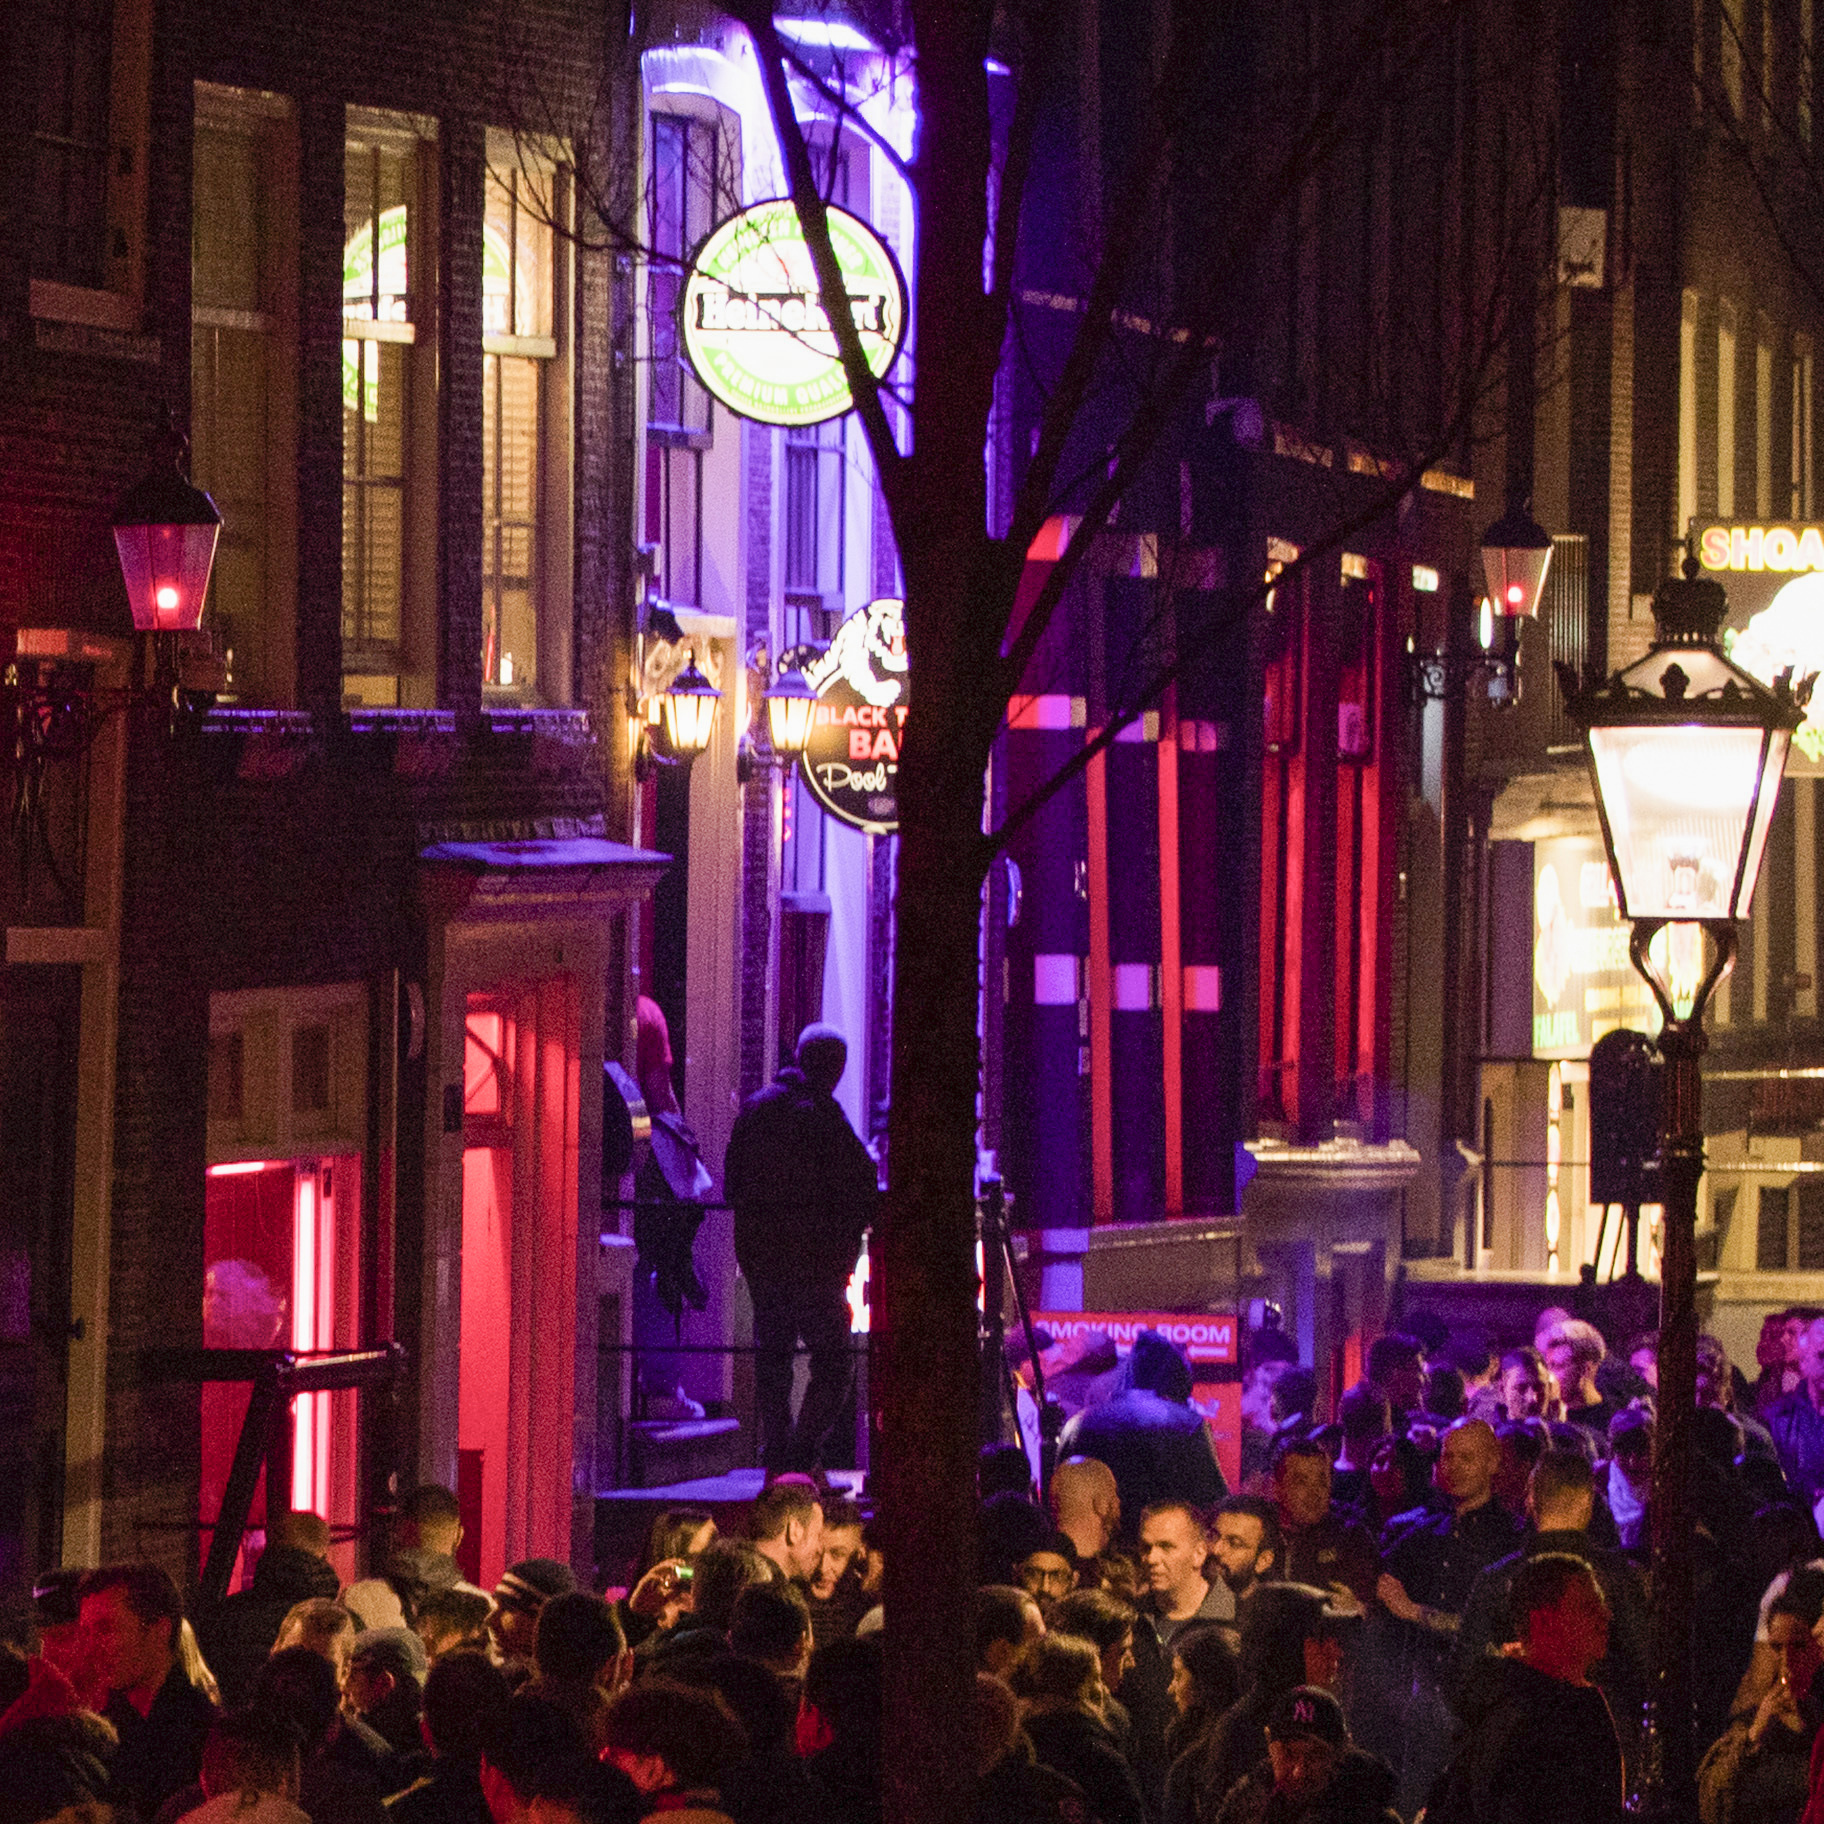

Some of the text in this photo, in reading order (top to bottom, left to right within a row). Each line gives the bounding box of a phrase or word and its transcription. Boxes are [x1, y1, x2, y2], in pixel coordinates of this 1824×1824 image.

[702, 292, 880, 330] Heinekn
[795, 366, 849, 405] QUAL
[816, 704, 887, 728] BLACK
[849, 728, 903, 761] BA
[816, 761, 888, 793] Pool
[1156, 1323, 1230, 1344] ROOM
